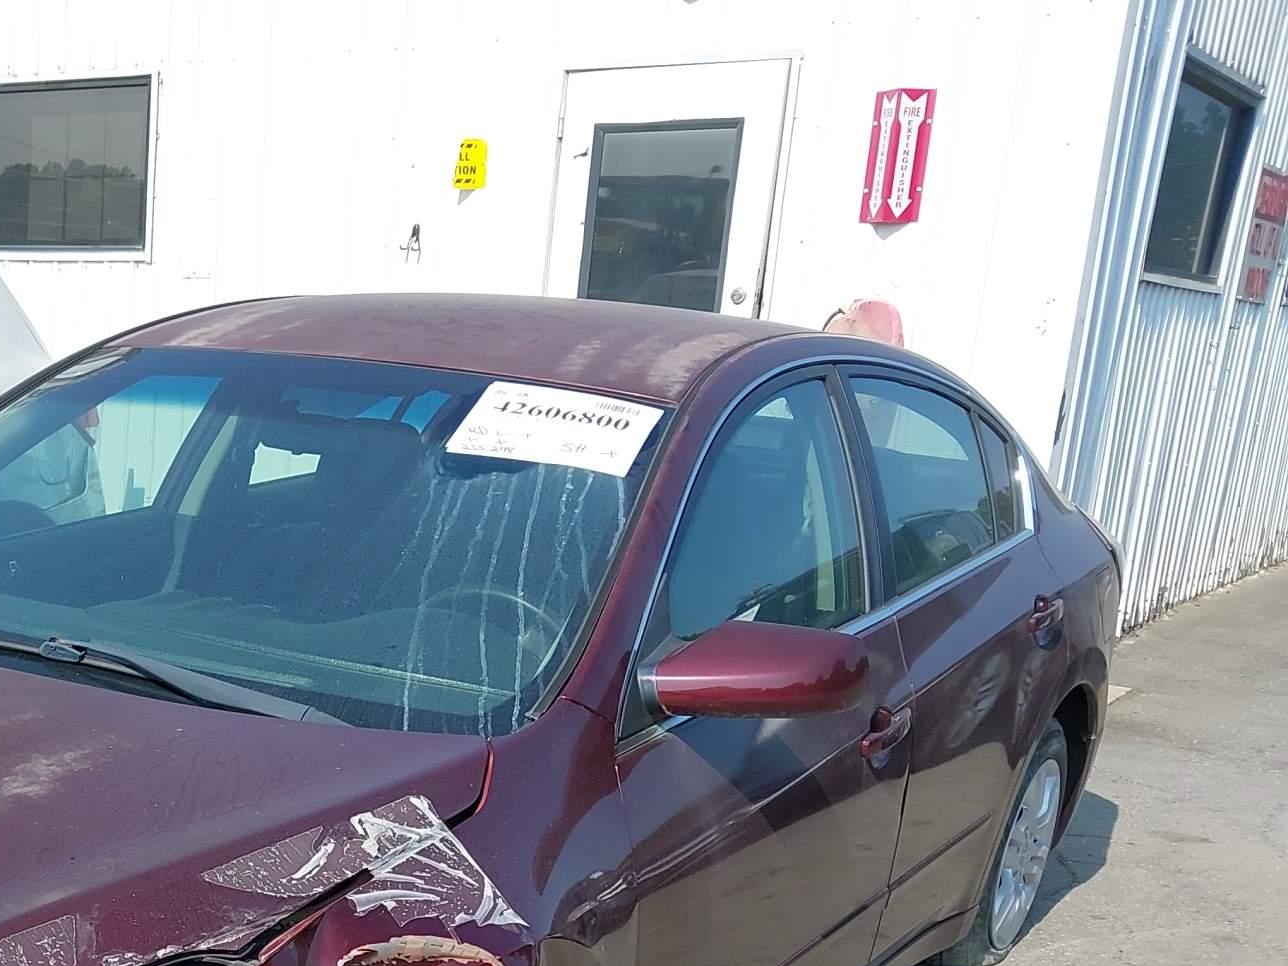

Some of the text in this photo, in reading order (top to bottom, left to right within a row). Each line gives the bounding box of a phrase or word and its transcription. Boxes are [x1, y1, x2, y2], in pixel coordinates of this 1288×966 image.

[903, 106, 921, 117] FIRE
[895, 119, 914, 208] EXTINGUISHER
[493, 400, 632, 431] 42606800
